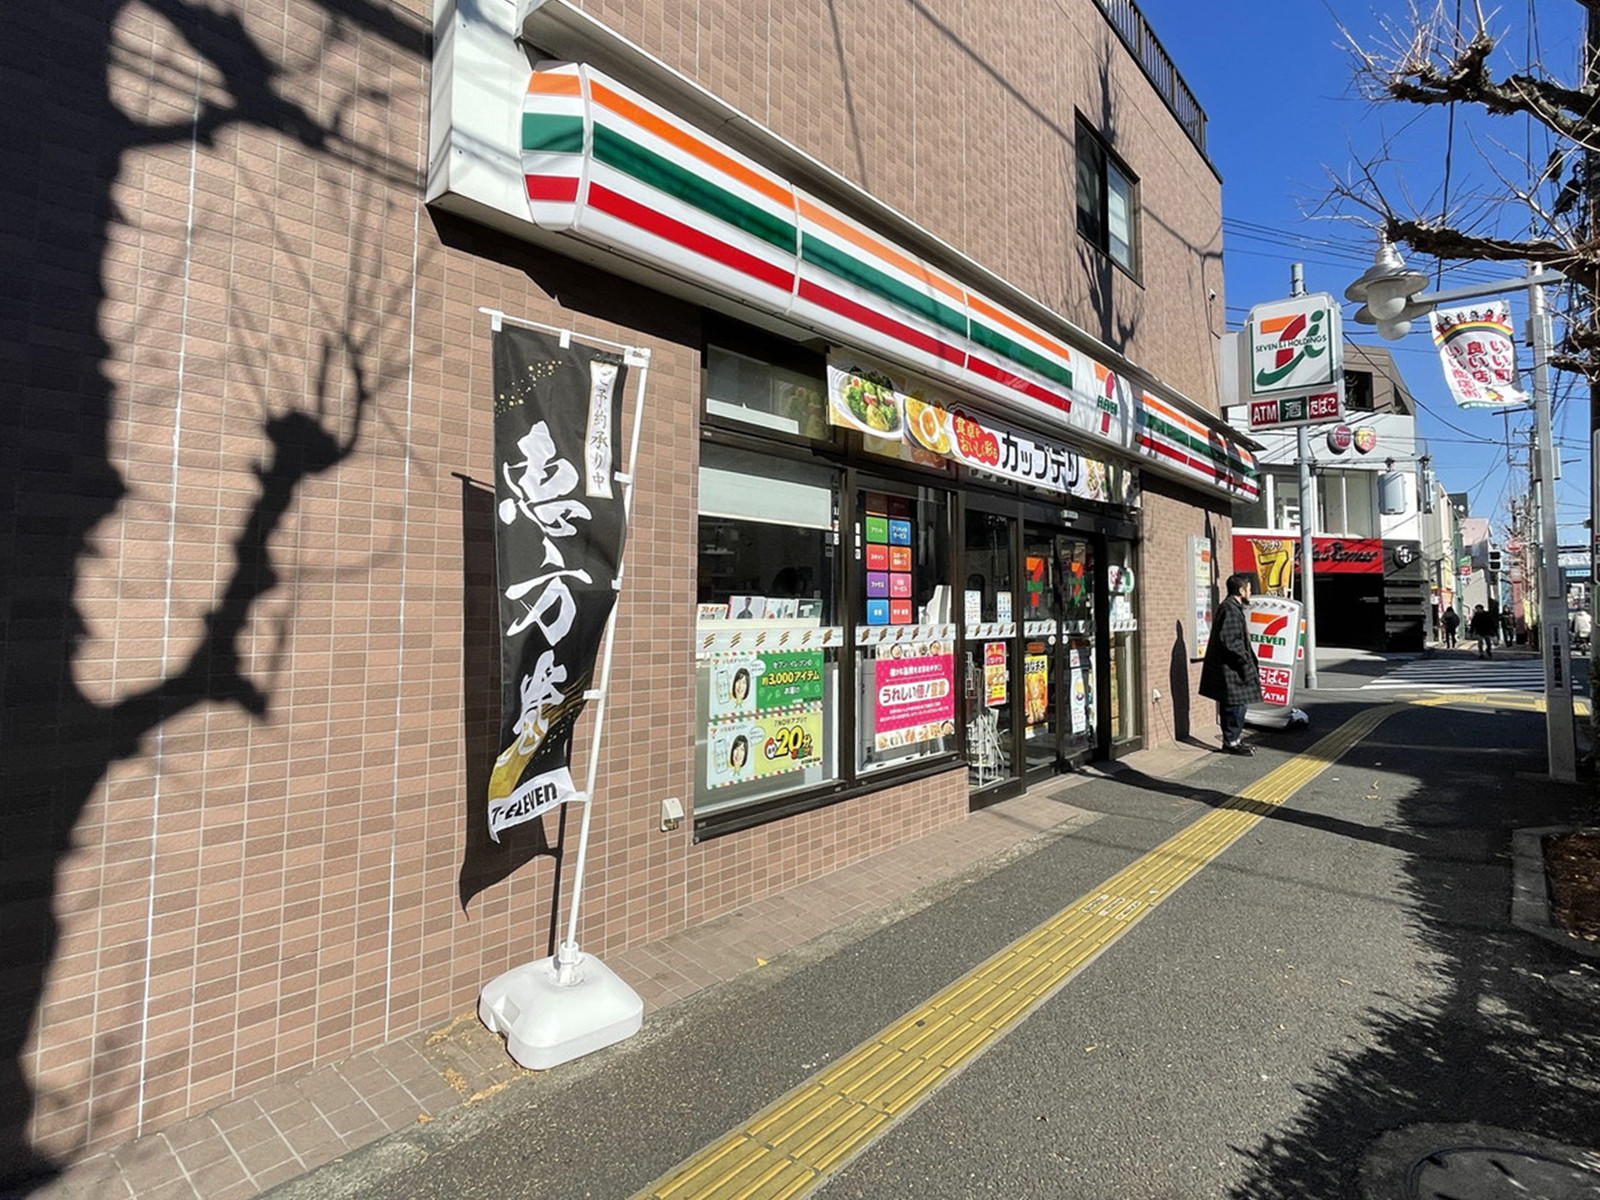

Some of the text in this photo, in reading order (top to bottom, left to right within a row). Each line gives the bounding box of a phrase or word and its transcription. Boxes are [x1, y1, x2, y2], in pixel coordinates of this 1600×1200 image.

[1255, 343, 1278, 353] SEVEN
[1287, 334, 1327, 348] HOLDINGS
[1253, 403, 1277, 422] ATM
[1285, 401, 1302, 419] 酒
[1310, 397, 1337, 416] たばこ
[590, 370, 613, 490] ご予約承り中
[1001, 431, 1080, 487] カップデリ
[1258, 550, 1288, 588] 7
[499, 420, 592, 755] 恵方巻
[1264, 692, 1285, 702] ATM
